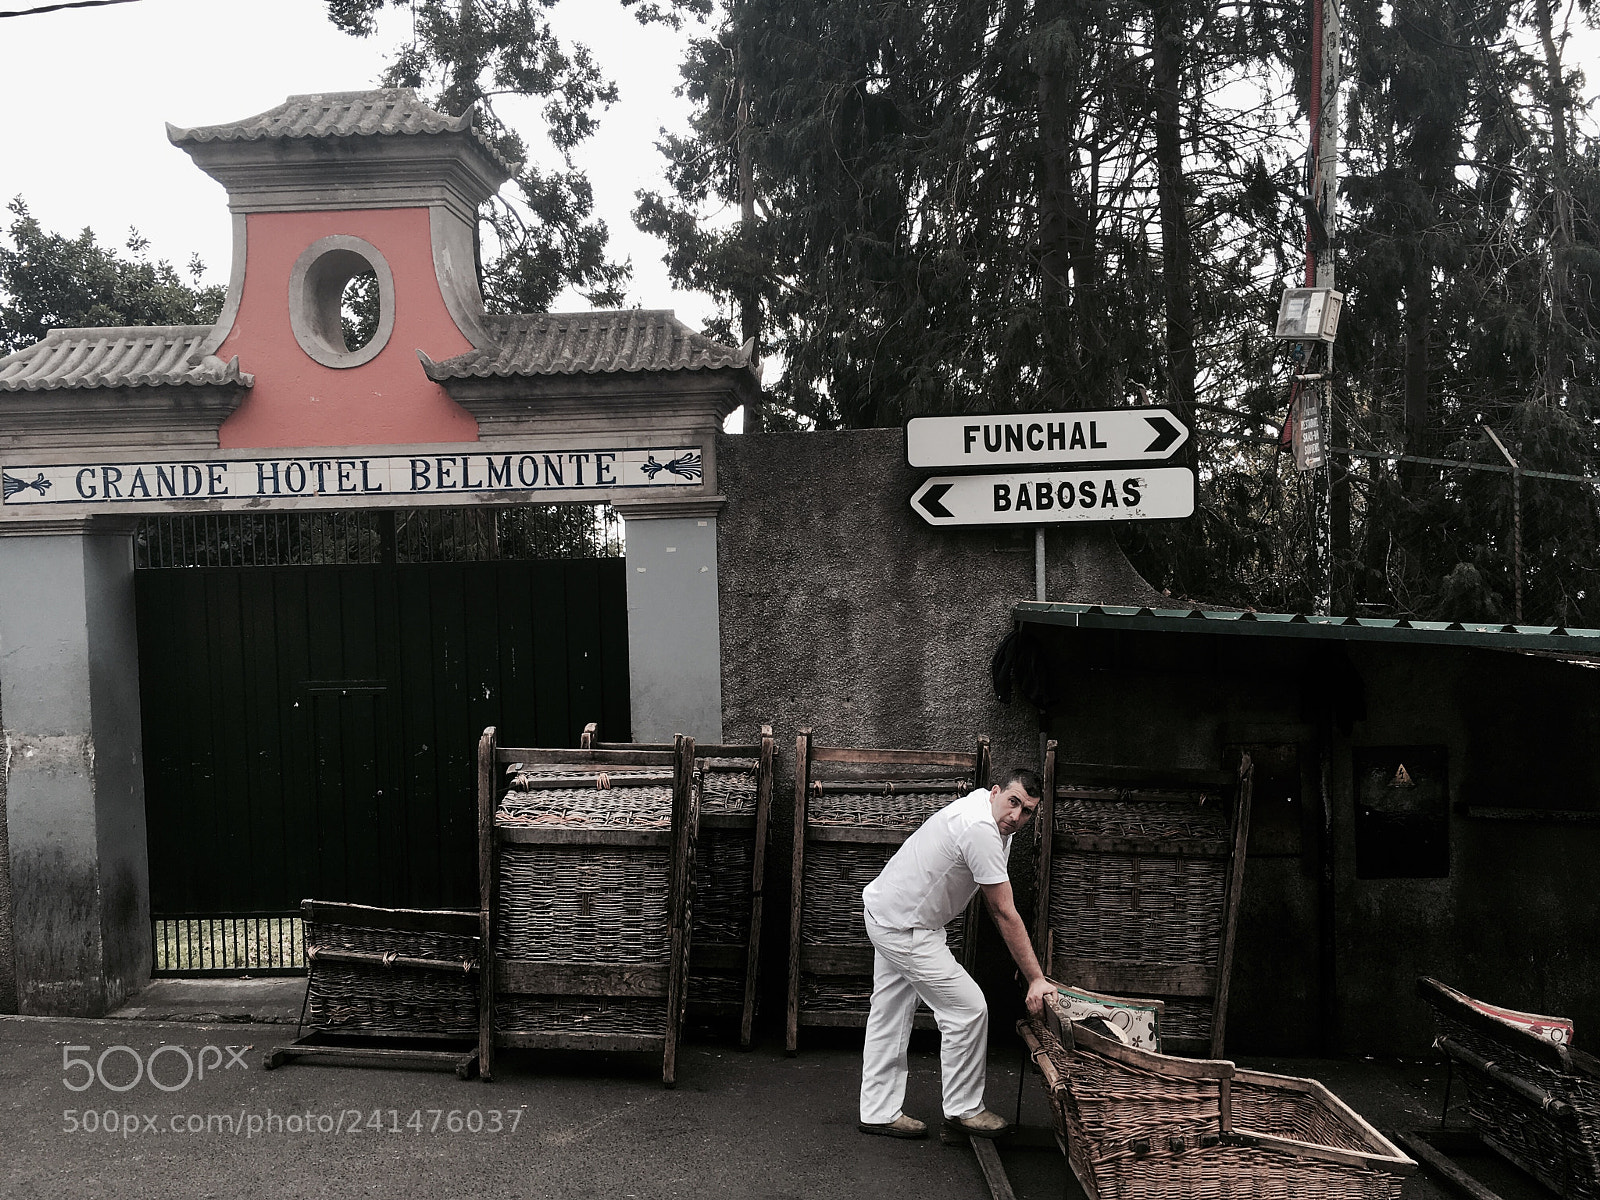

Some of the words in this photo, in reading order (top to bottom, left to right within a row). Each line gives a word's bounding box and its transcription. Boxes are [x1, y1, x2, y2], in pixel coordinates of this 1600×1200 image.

[963, 421, 1107, 453] FUNCHAL
[75, 463, 229, 499] GRANDE
[255, 460, 382, 494] HOTEL
[409, 453, 617, 491] BELMONTE
[993, 479, 1142, 512] BABOSAS
